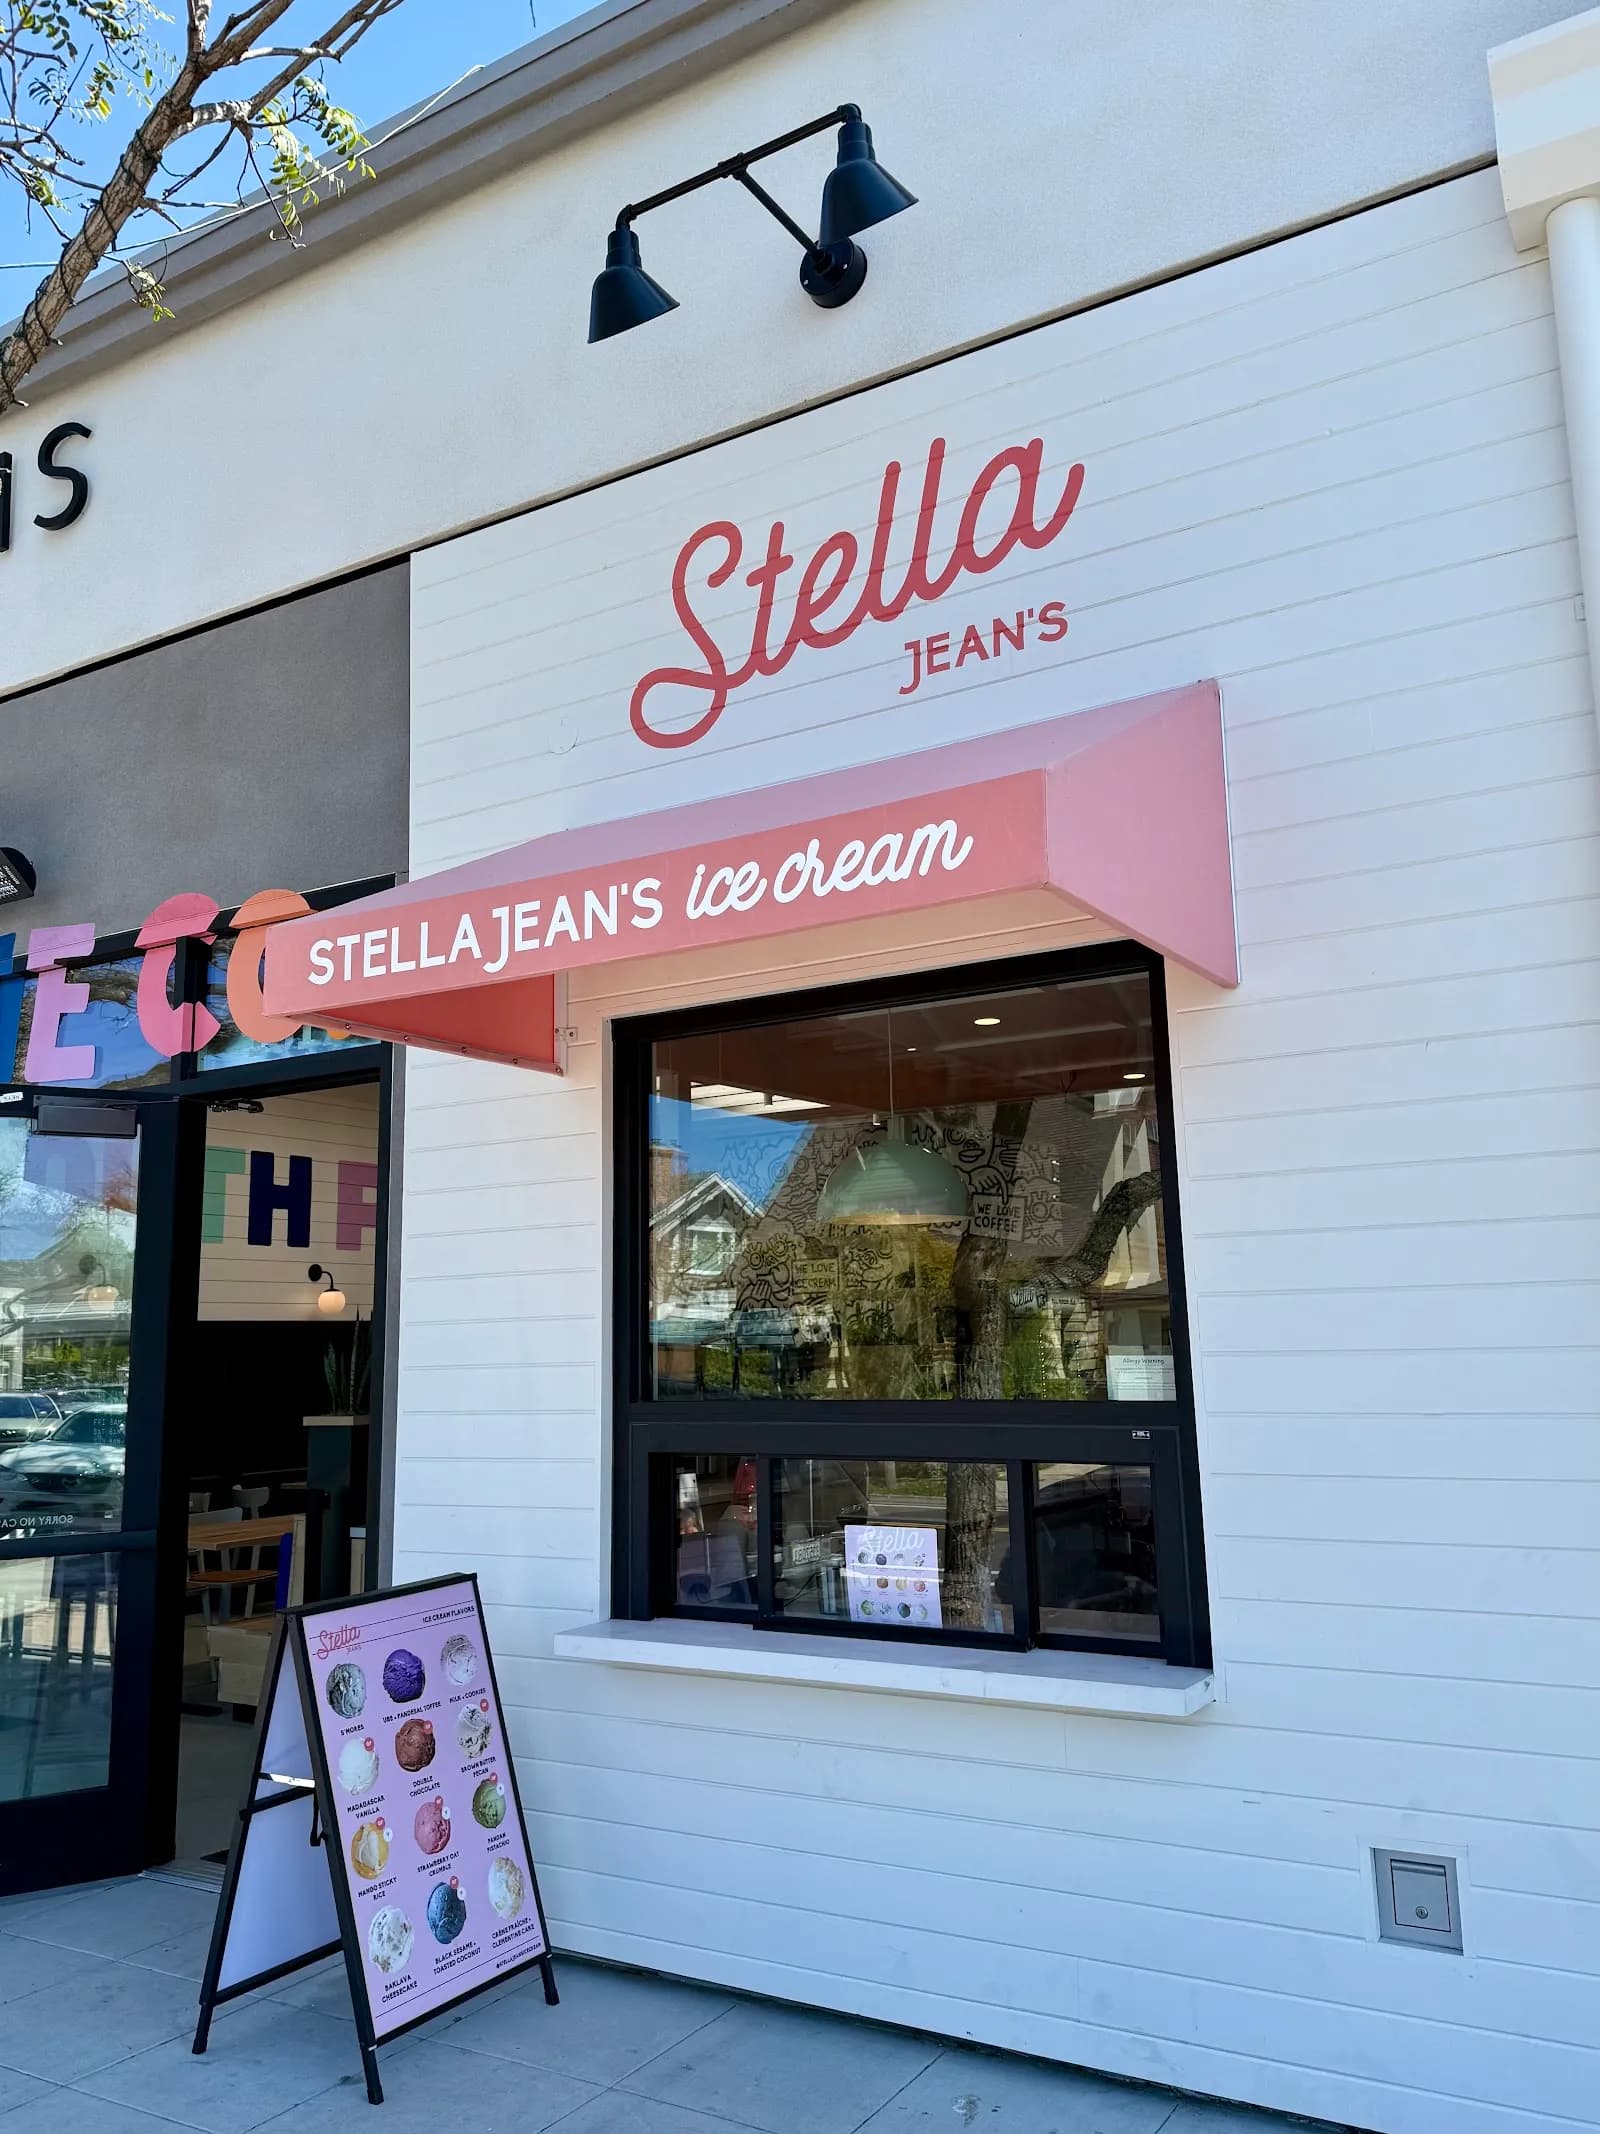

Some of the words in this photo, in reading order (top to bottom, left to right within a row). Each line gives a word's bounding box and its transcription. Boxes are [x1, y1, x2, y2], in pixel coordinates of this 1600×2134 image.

[630, 437, 1085, 749] Stella
[899, 601, 1069, 695] JEAN'S
[308, 914, 482, 985] STELLA
[483, 877, 664, 975] JEAN'S
[685, 860, 769, 921] ice
[772, 818, 973, 904] cream
[977, 1203, 992, 1215] WE
[996, 1205, 1021, 1218] LOVE
[974, 1216, 1018, 1232] COFFEE
[811, 1262, 837, 1273] LOVE
[422, 1615, 432, 1623] ICE
[432, 1611, 451, 1621] CREAM
[451, 1605, 475, 1617] FLAVORS
[316, 1624, 361, 1660] Stella
[449, 1694, 462, 1704] MILK
[465, 1687, 487, 1699] COOKIES
[397, 1707, 423, 1720] PANDESAL
[423, 1701, 442, 1712] TOFFEE
[460, 1762, 479, 1773] BROWN
[479, 1756, 496, 1767] BUTTER
[473, 1768, 489, 1777] PECAN
[409, 1782, 441, 1797] CHOCOLATE
[412, 1775, 433, 1787] DOUBLE
[347, 1795, 385, 1814] MADAGASCAR
[356, 1807, 380, 1819] VANILLA
[417, 1854, 450, 1873] STRAWBERRY
[428, 1863, 452, 1877] CRUMBLE
[358, 1883, 378, 1898] MANGO
[379, 1877, 397, 1888] STICKY
[373, 1890, 386, 1901] RICE
[491, 1930, 521, 1948] CLEMENTINE
[521, 1923, 535, 1934] CAKE
[433, 1960, 457, 1975] TOASTED
[456, 1947, 481, 1964] COCONUT
[435, 1953, 452, 1965] BLACK
[453, 1941, 473, 1956] SESAME
[381, 1981, 418, 2003] CHEESECAKE
[384, 1974, 412, 1992] BAKLAVA
